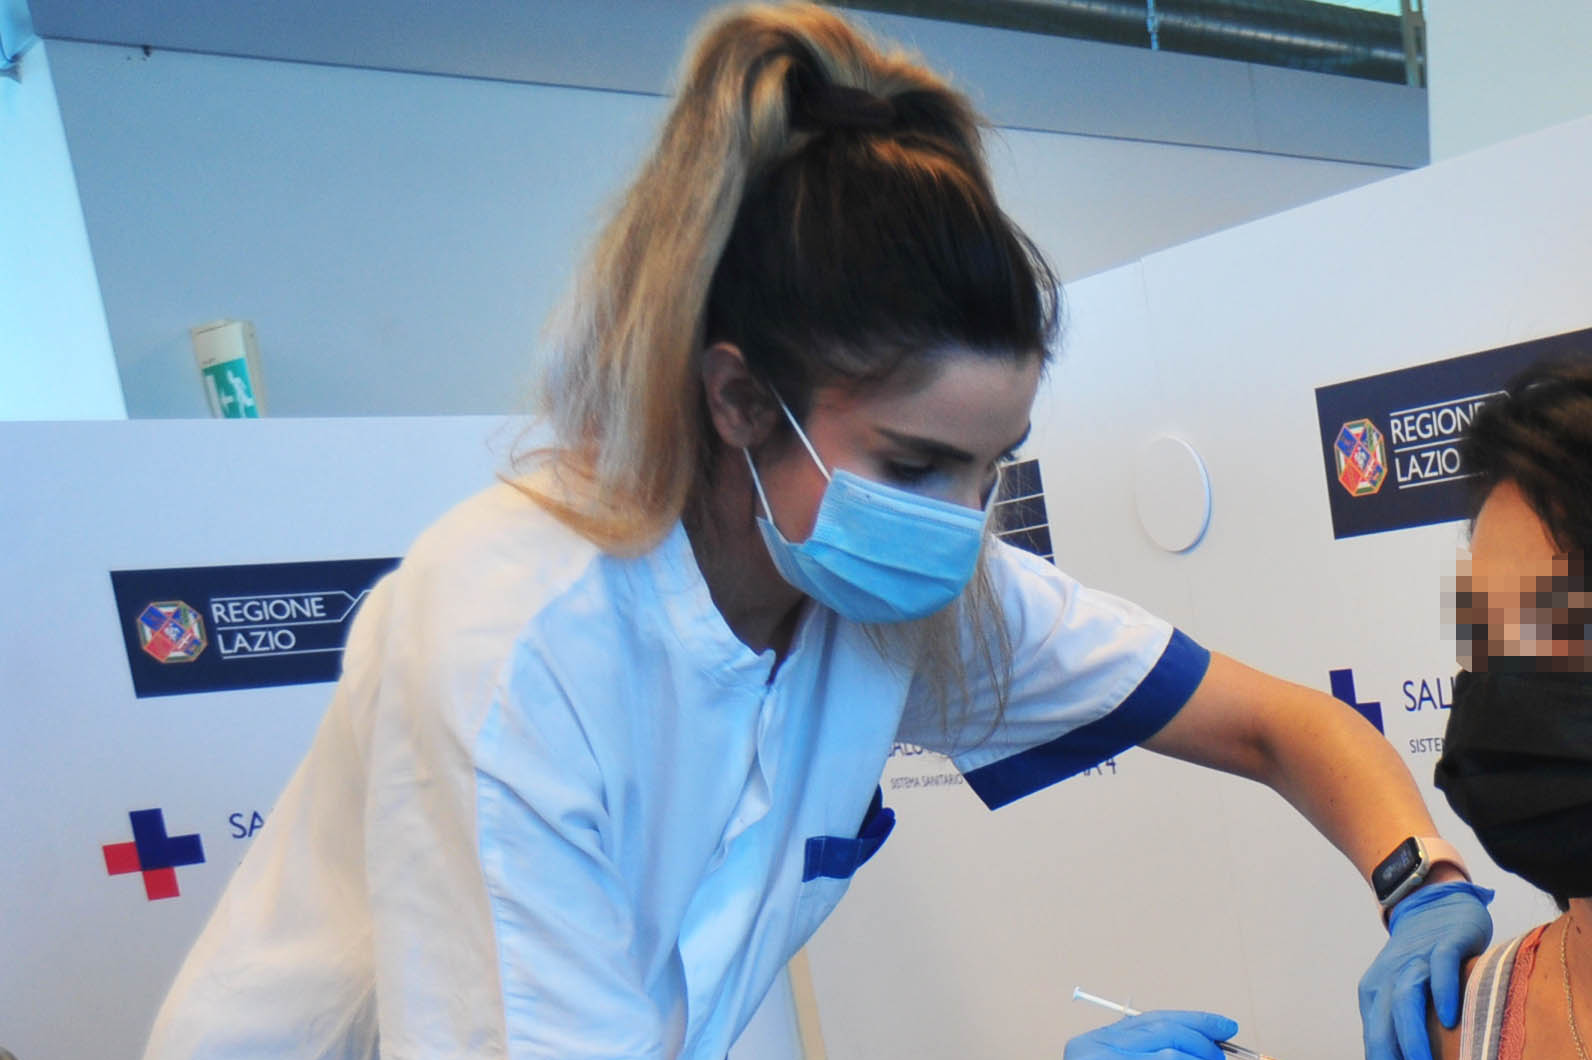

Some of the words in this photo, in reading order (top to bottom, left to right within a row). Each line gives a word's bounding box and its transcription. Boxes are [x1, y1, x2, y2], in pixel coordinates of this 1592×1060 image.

[1395, 448, 1460, 482] LAZIO
[211, 597, 326, 624] REGIONE
[217, 629, 296, 654] LAZIO
[1409, 737, 1444, 754] SISTE
